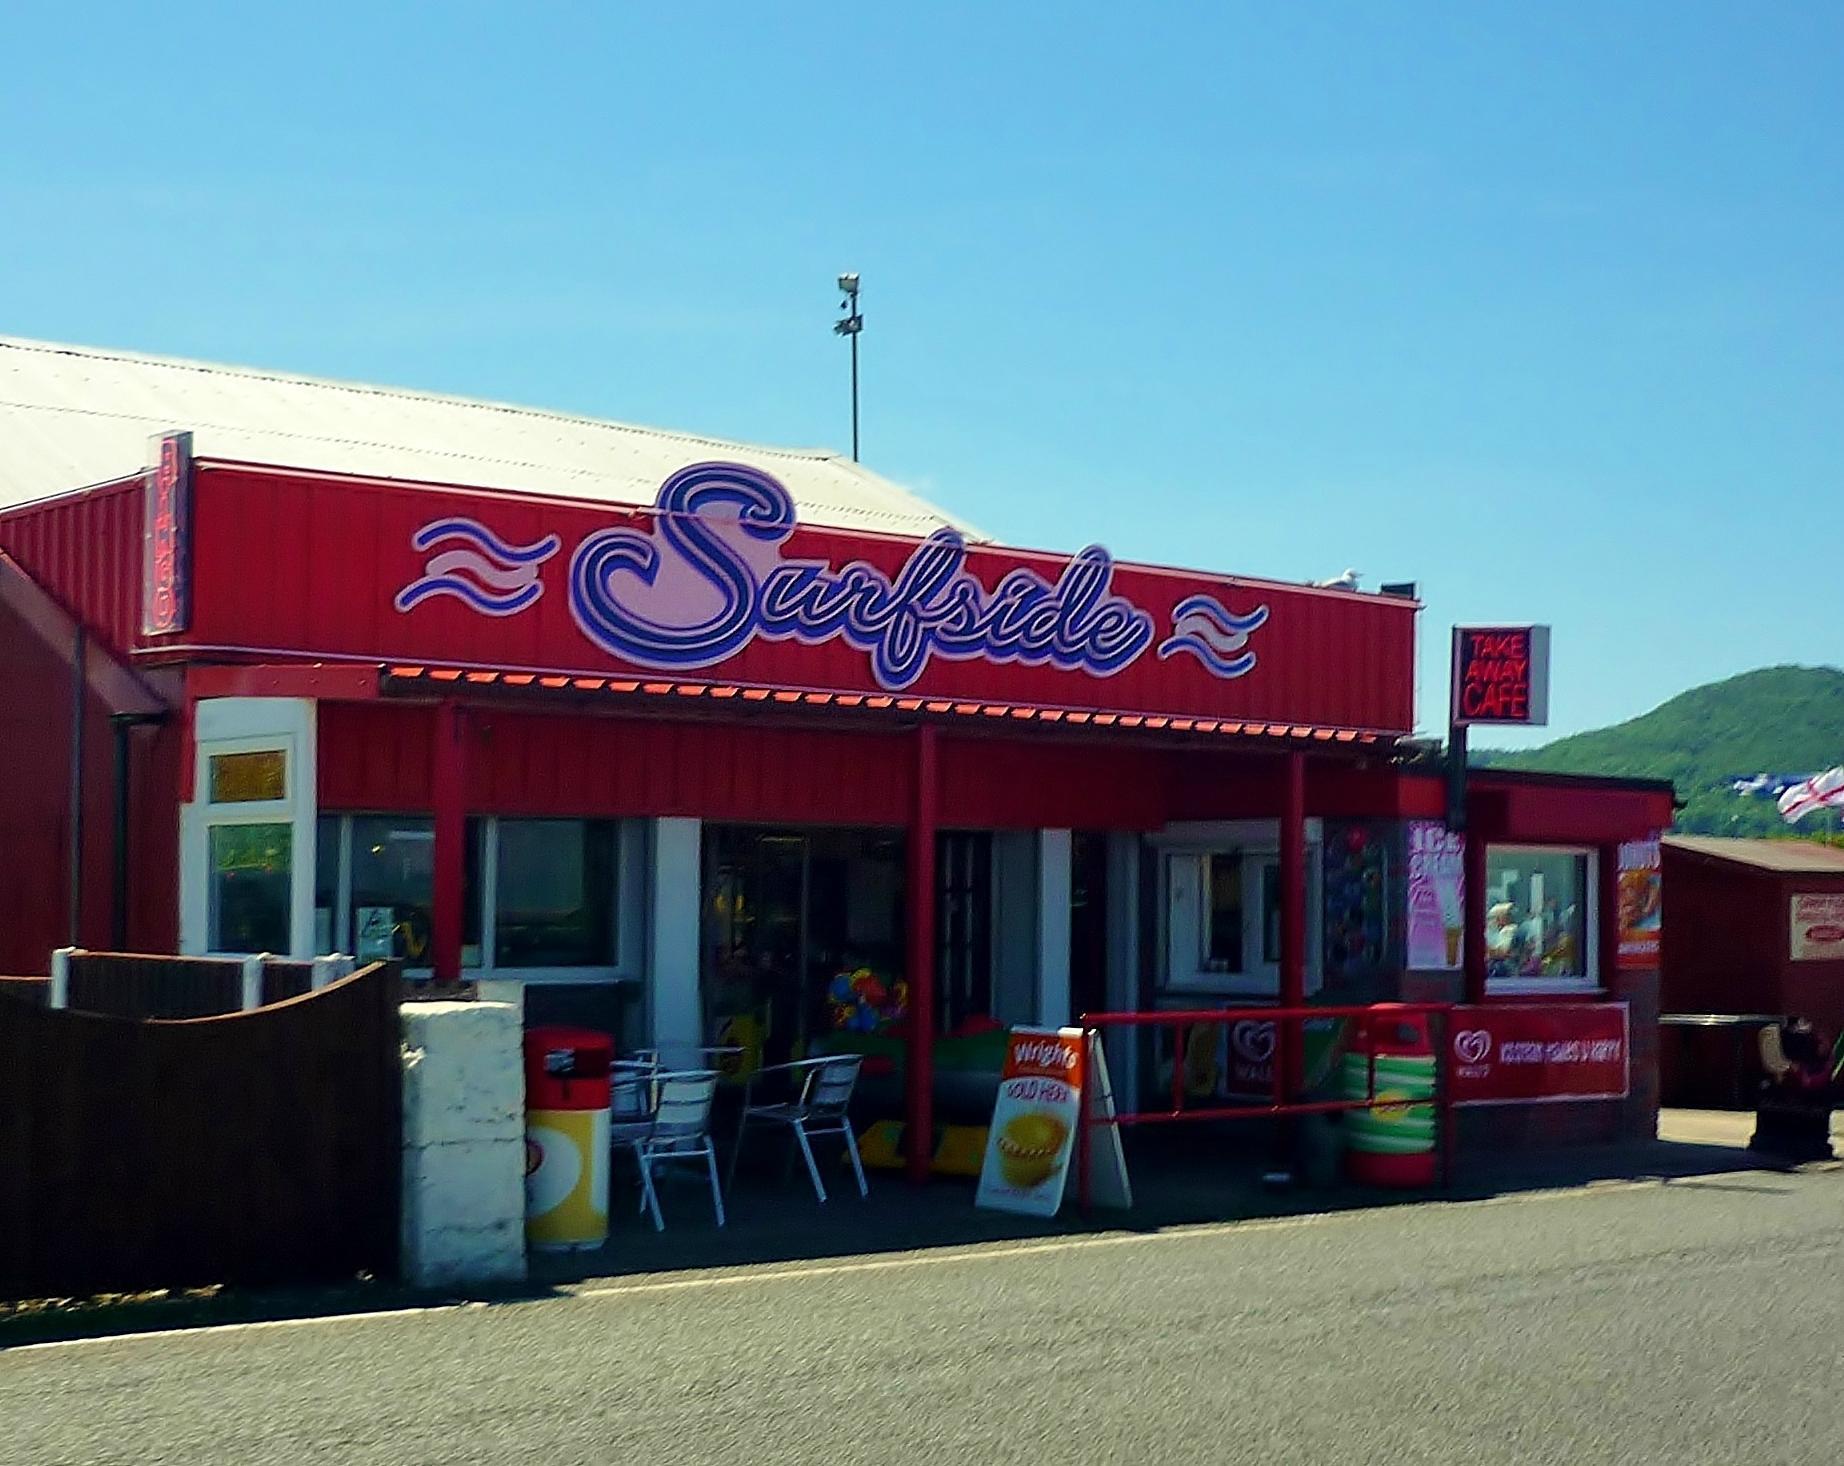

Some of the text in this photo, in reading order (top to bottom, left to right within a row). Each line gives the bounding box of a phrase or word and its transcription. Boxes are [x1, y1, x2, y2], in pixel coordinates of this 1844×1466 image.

[570, 462, 1154, 690] Surfside
[1471, 633, 1525, 659] TAKE
[1465, 659, 1527, 683] AWAY
[1462, 682, 1526, 717] CAFE
